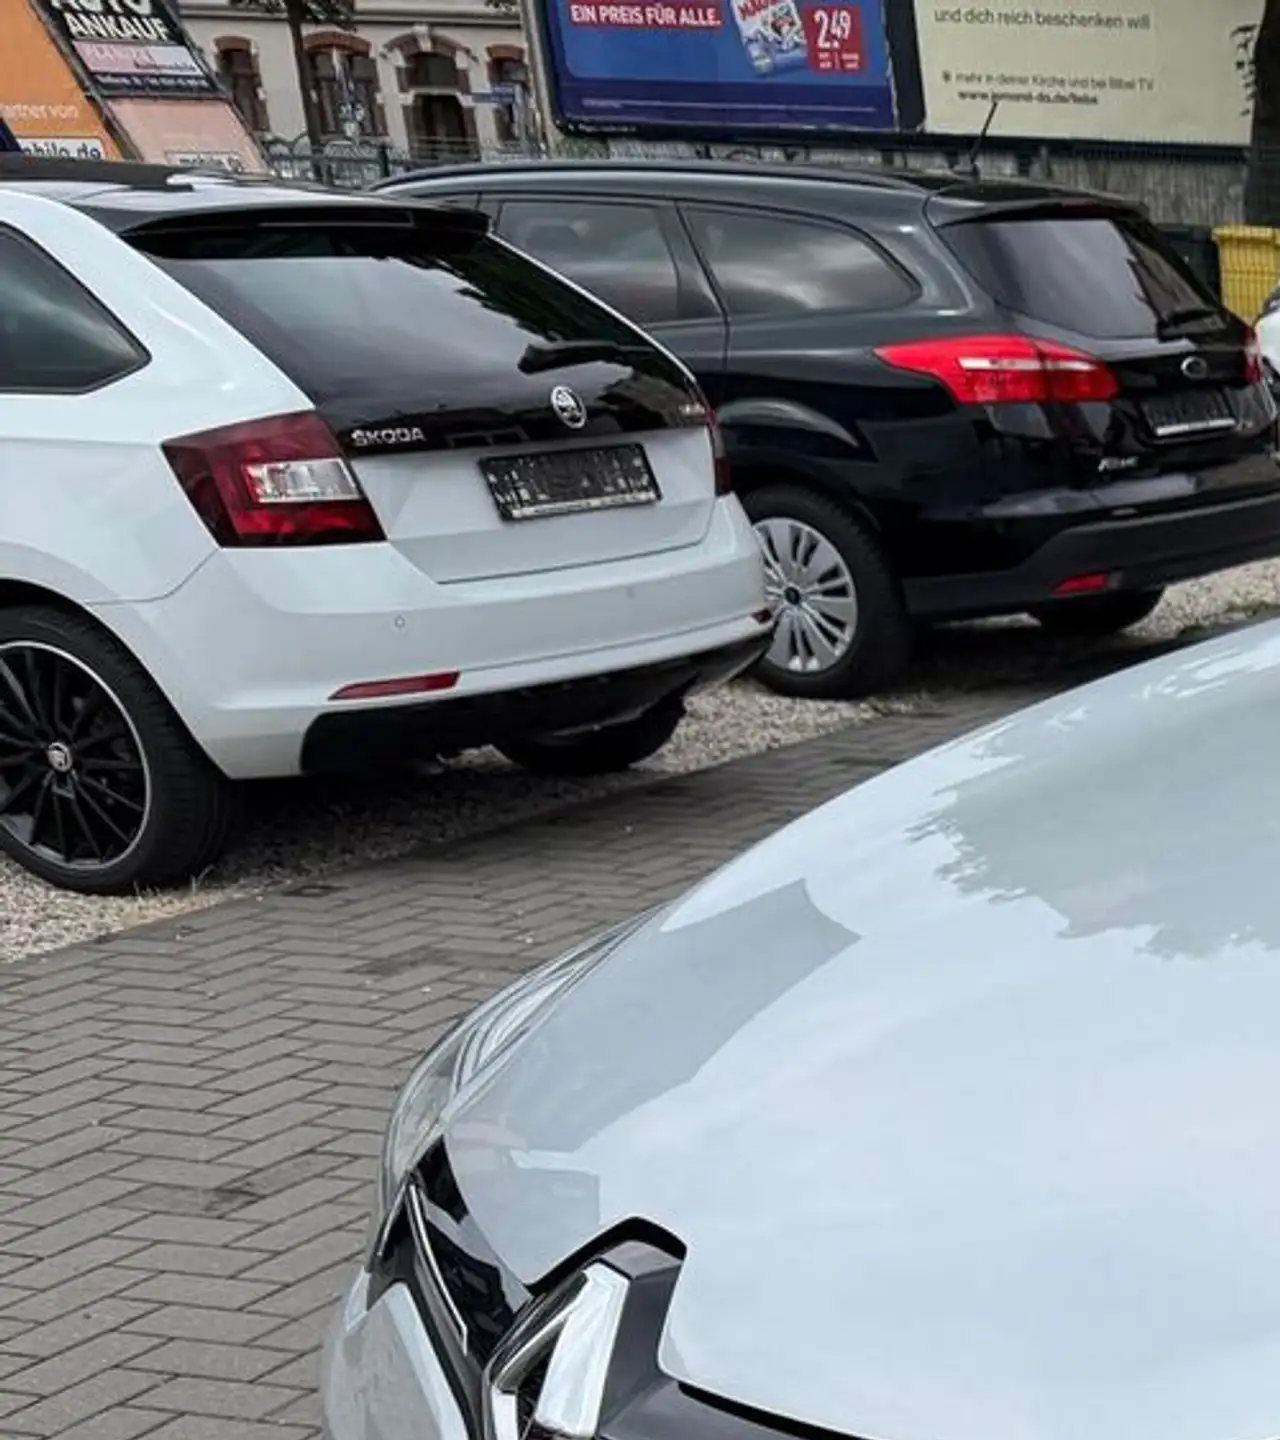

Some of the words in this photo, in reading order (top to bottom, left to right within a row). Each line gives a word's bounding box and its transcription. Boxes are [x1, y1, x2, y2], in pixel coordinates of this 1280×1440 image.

[63, 12, 169, 40] ANKAUF
[571, 5, 598, 23] EIN
[600, 6, 643, 25] PREIS
[645, 3, 678, 25] FÜR
[680, 8, 722, 26] ALLE.
[934, 8, 961, 24] und
[963, 9, 994, 25] dich
[997, 11, 1033, 26] reich
[1036, 12, 1123, 29] beschenken
[1127, 13, 1150, 30] will
[814, 10, 851, 49] 2.49
